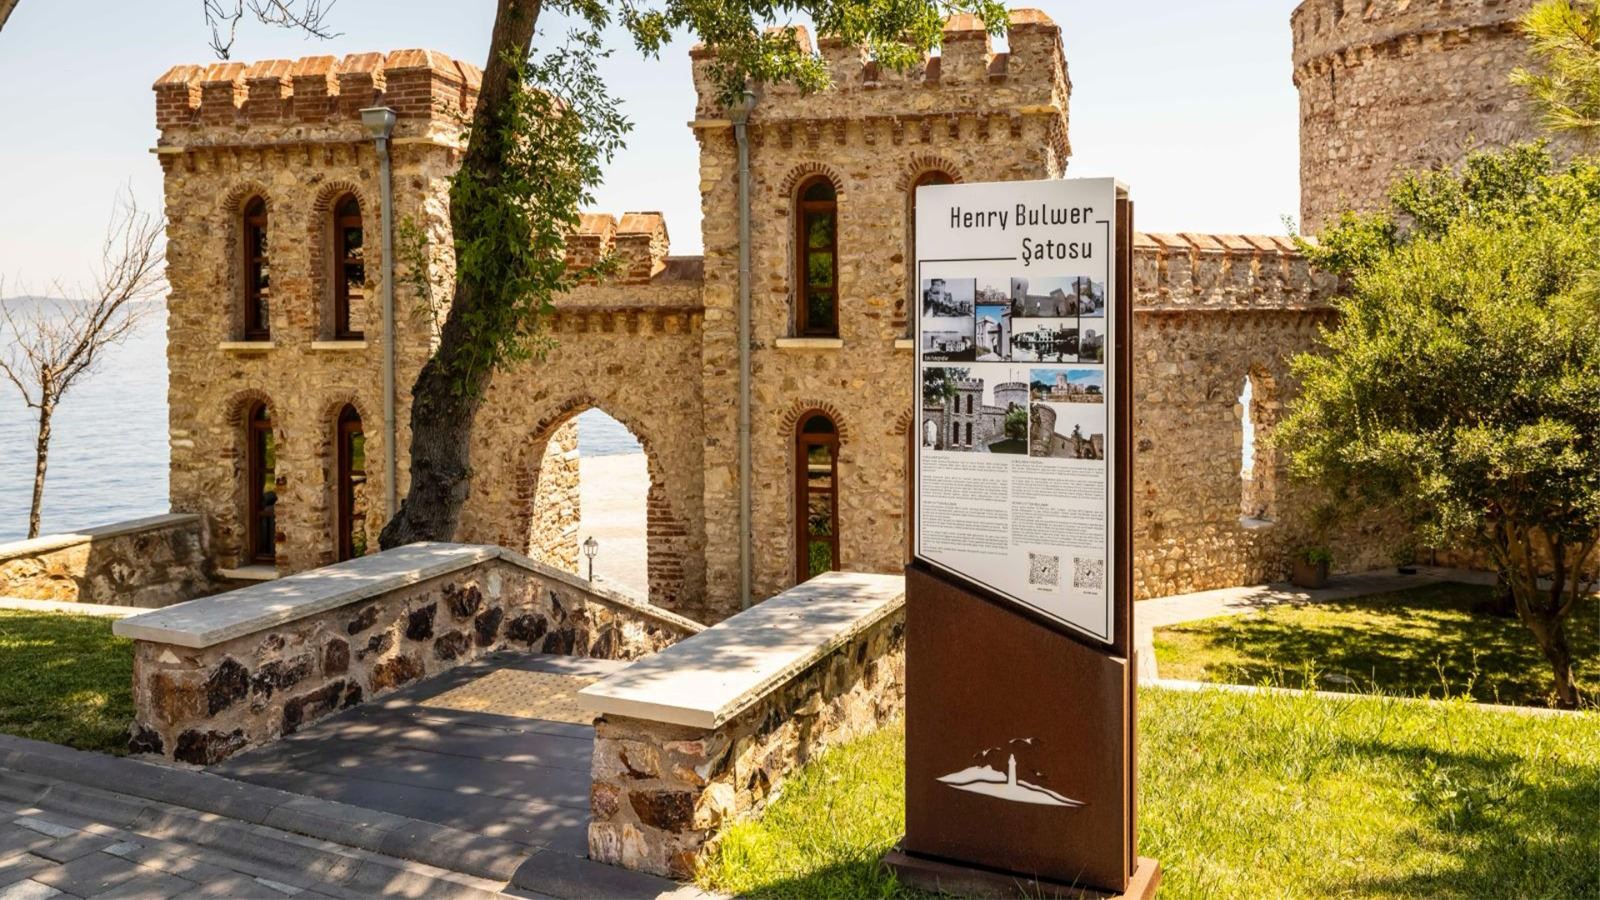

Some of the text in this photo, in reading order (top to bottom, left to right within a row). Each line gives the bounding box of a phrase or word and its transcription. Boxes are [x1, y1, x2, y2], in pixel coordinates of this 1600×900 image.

[950, 204, 1094, 231] Henry Bulwer
[1021, 237, 1092, 266] Şatosu
